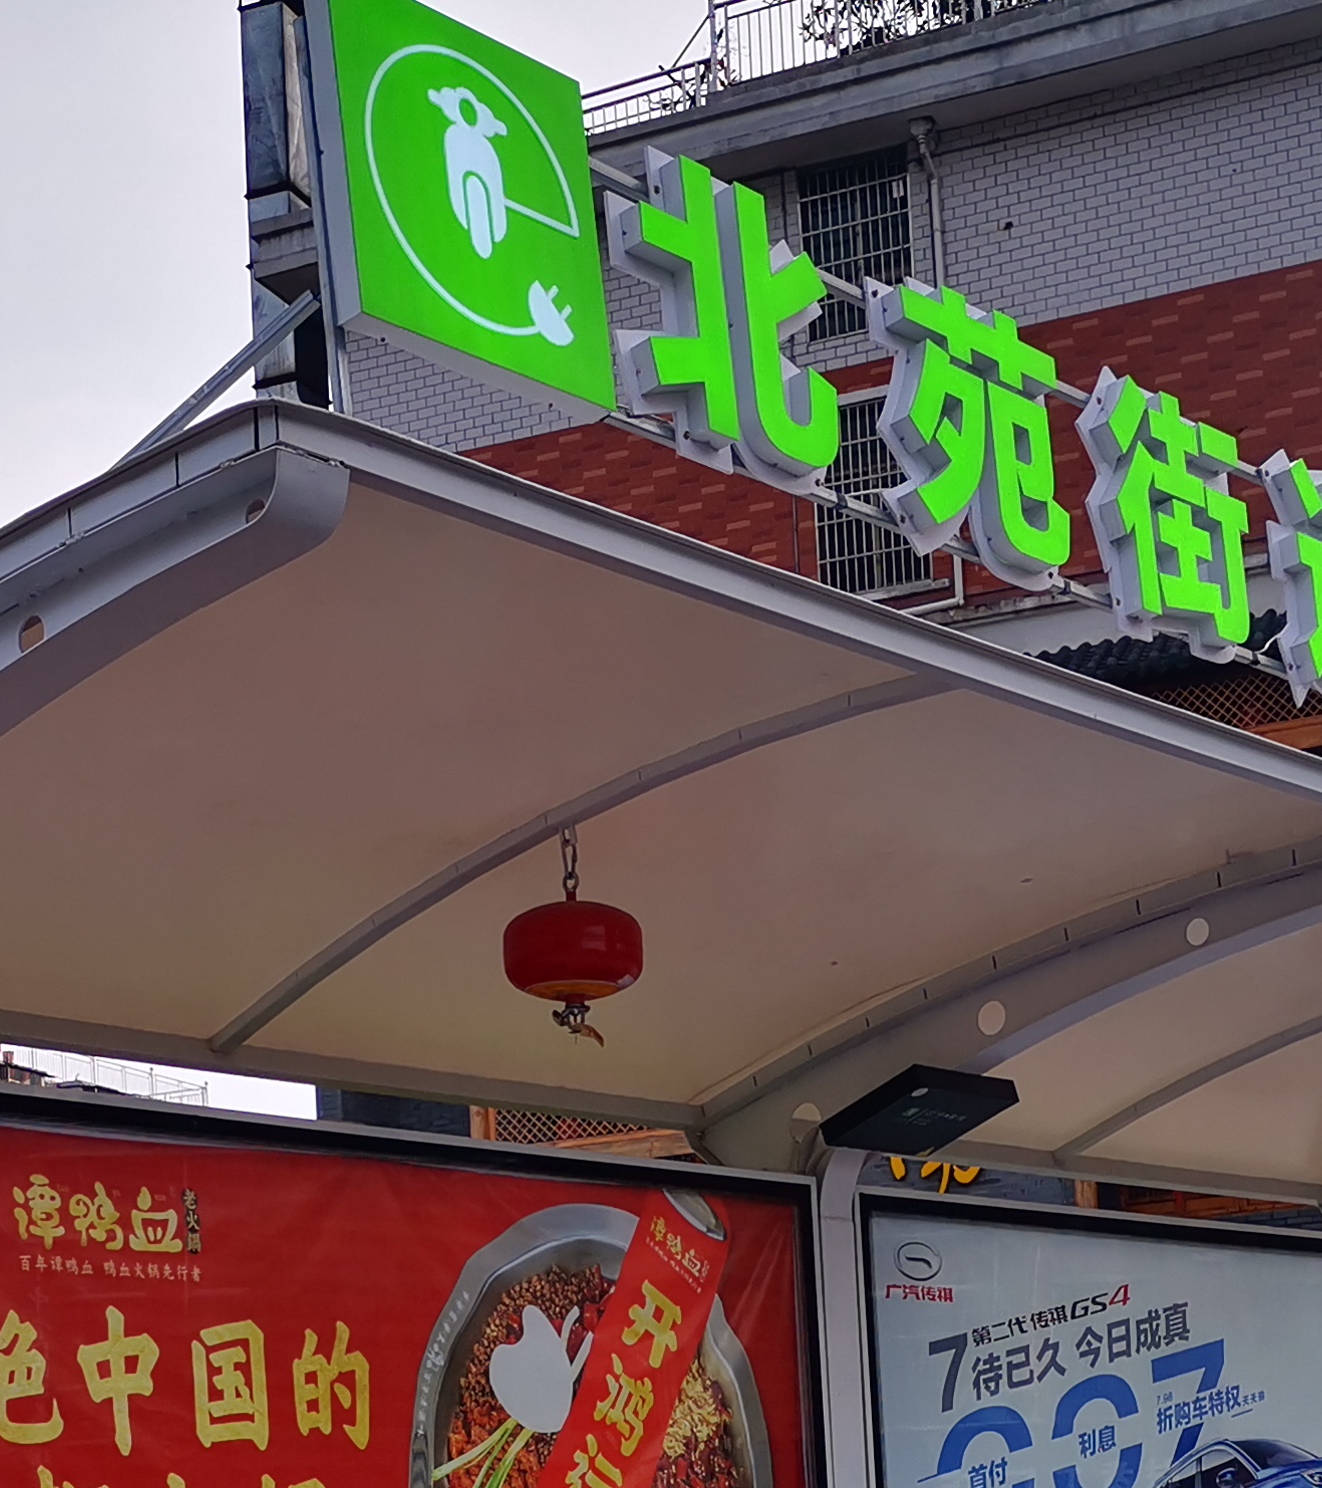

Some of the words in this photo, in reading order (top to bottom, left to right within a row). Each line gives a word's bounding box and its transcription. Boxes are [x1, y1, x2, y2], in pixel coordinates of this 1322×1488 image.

[885, 1284, 954, 1303] 广汽传祺
[971, 1315, 1028, 1347] 第二代
[1030, 1283, 1131, 1331] 传祺GS4
[1075, 1301, 1191, 1370] 今日成真
[1156, 1384, 1241, 1435] 折购车特权
[1077, 1424, 1117, 1459] 利息
